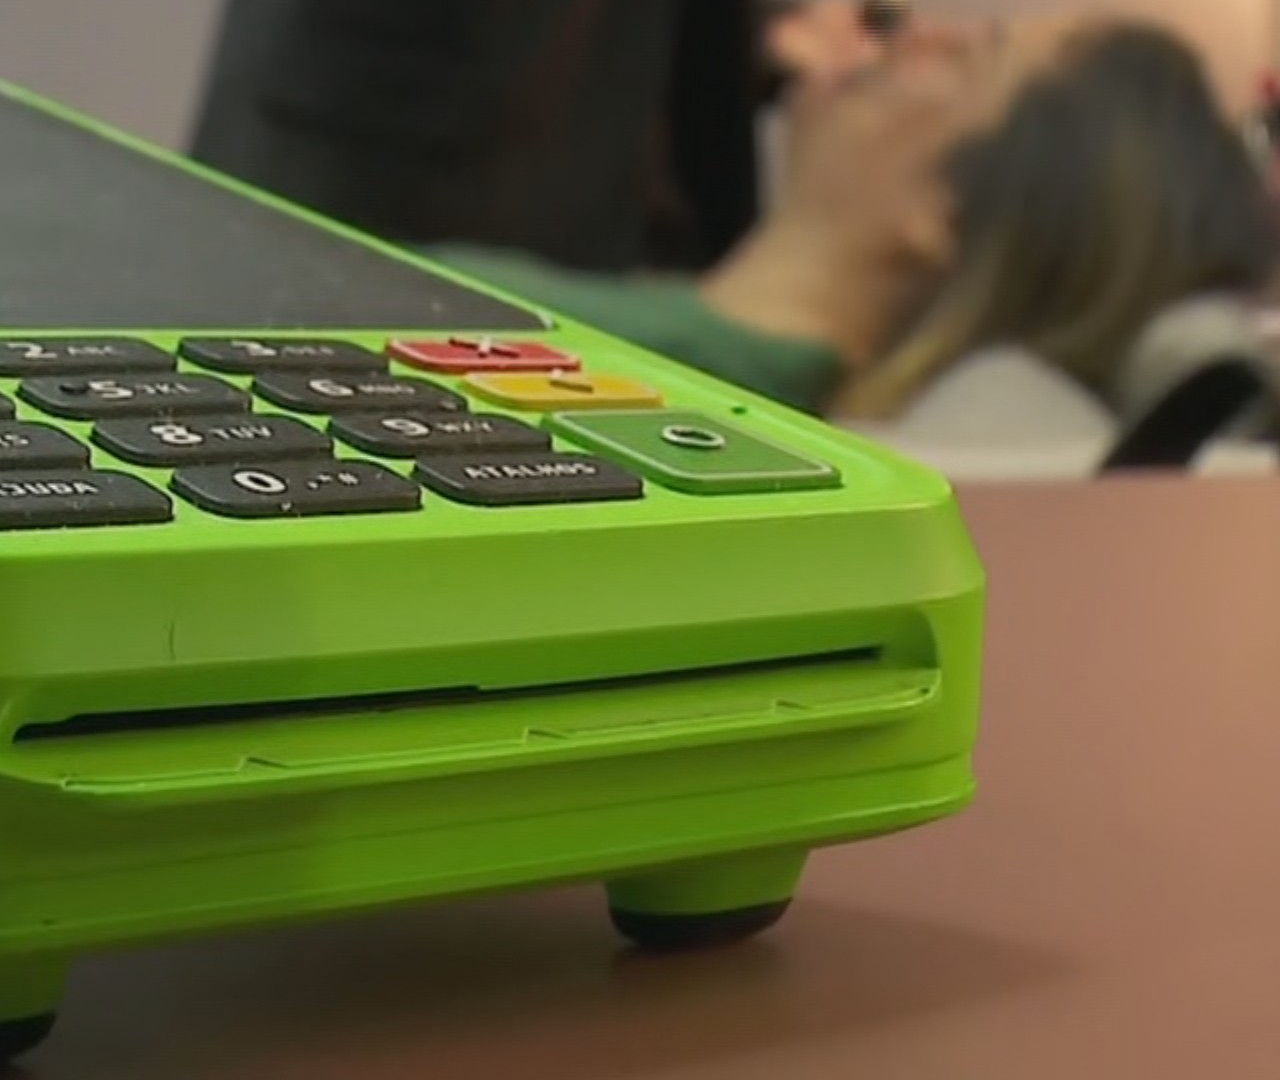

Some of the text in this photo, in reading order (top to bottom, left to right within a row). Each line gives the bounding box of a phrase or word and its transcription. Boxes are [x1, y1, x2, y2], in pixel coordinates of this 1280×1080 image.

[6, 341, 58, 358] 2
[88, 380, 134, 399] 5
[309, 378, 355, 396] 6
[150, 423, 204, 444] 8
[381, 418, 430, 437] 9
[232, 470, 288, 494] 0
